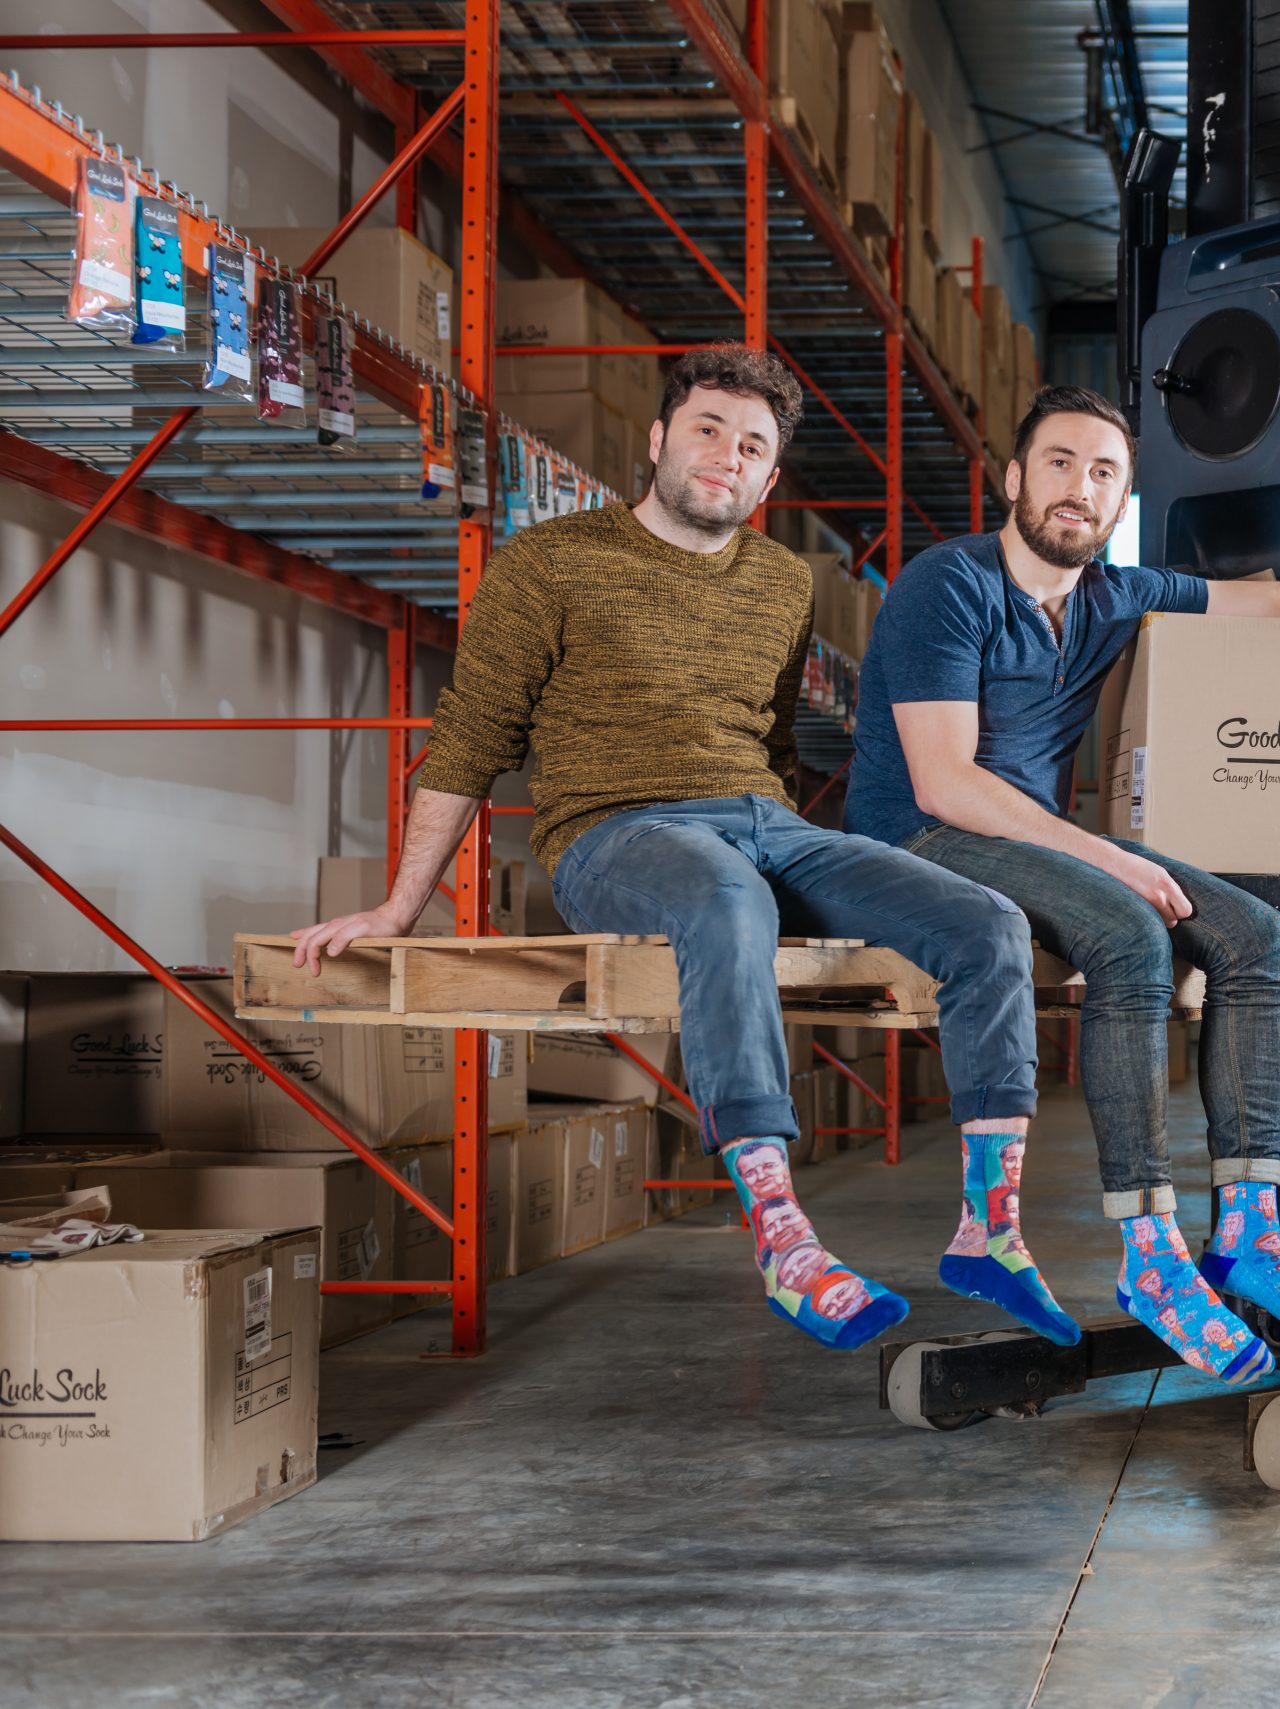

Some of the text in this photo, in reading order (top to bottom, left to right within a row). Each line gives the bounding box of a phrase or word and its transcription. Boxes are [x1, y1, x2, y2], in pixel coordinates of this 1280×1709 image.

[1212, 767, 1254, 790] Change
[206, 1062, 240, 1085] Sock
[0, 1367, 108, 1407] Luck Sock
[8, 1423, 110, 1447] Change Your Sock
